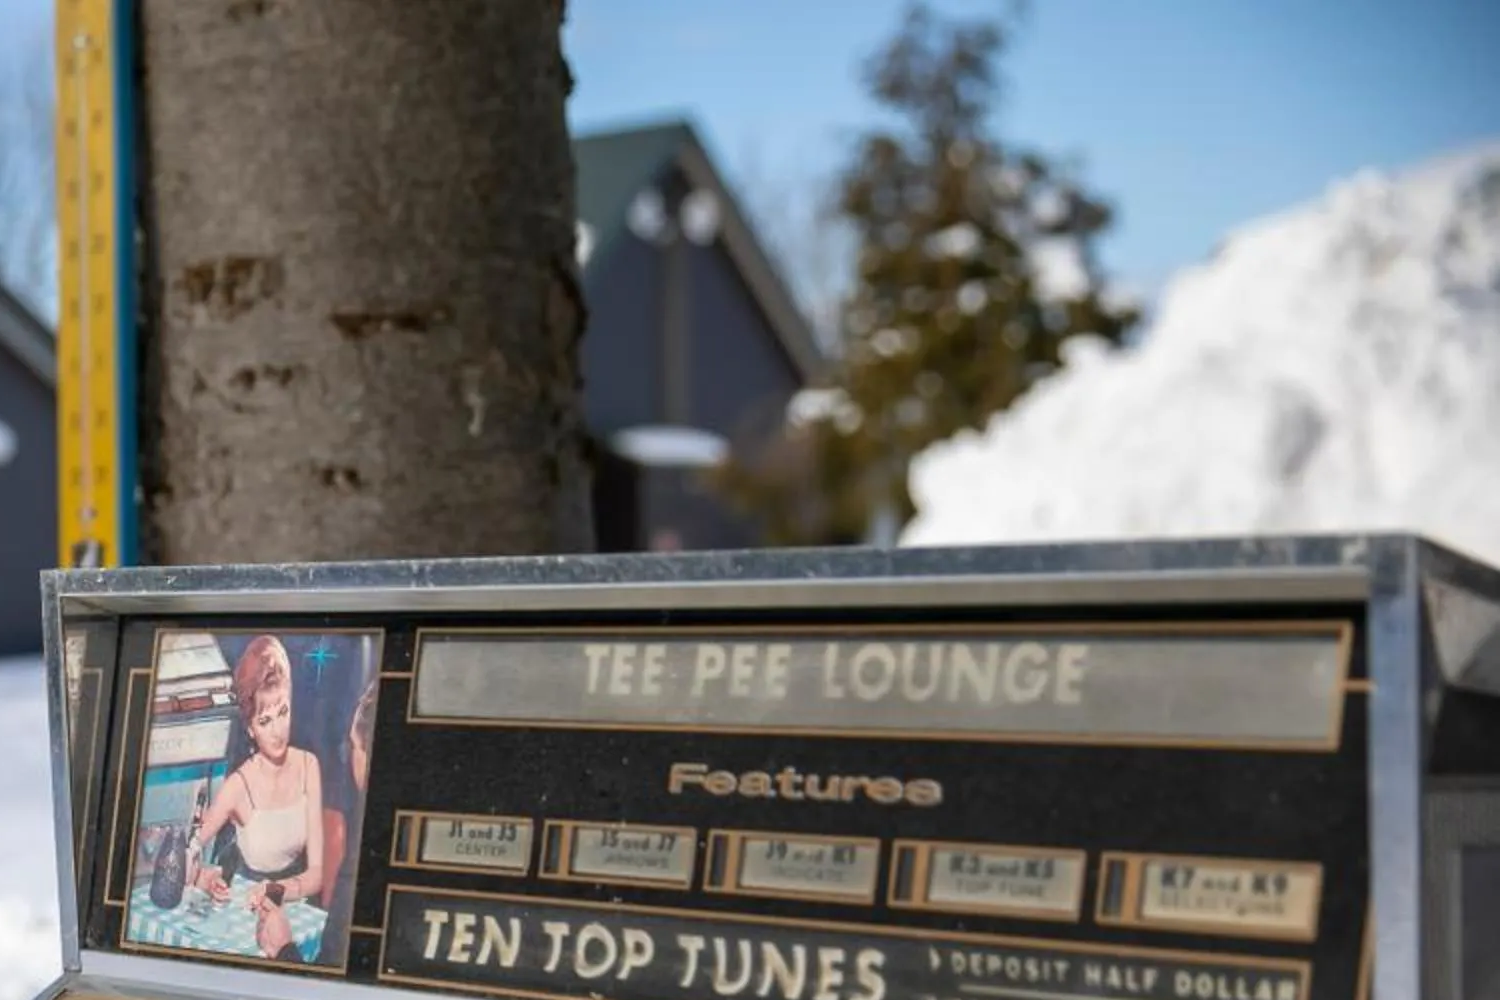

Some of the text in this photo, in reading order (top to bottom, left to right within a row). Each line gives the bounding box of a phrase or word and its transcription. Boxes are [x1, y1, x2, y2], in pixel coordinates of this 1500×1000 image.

[584, 641, 1090, 704] TEE PEE LOUNGE
[667, 762, 944, 807] Features
[469, 826, 492, 840] and
[622, 837, 650, 850] and
[424, 909, 521, 968] TEN
[542, 921, 655, 979] TOP
[950, 951, 1070, 984] DEPOSIT
[1084, 959, 1159, 992] HALF
